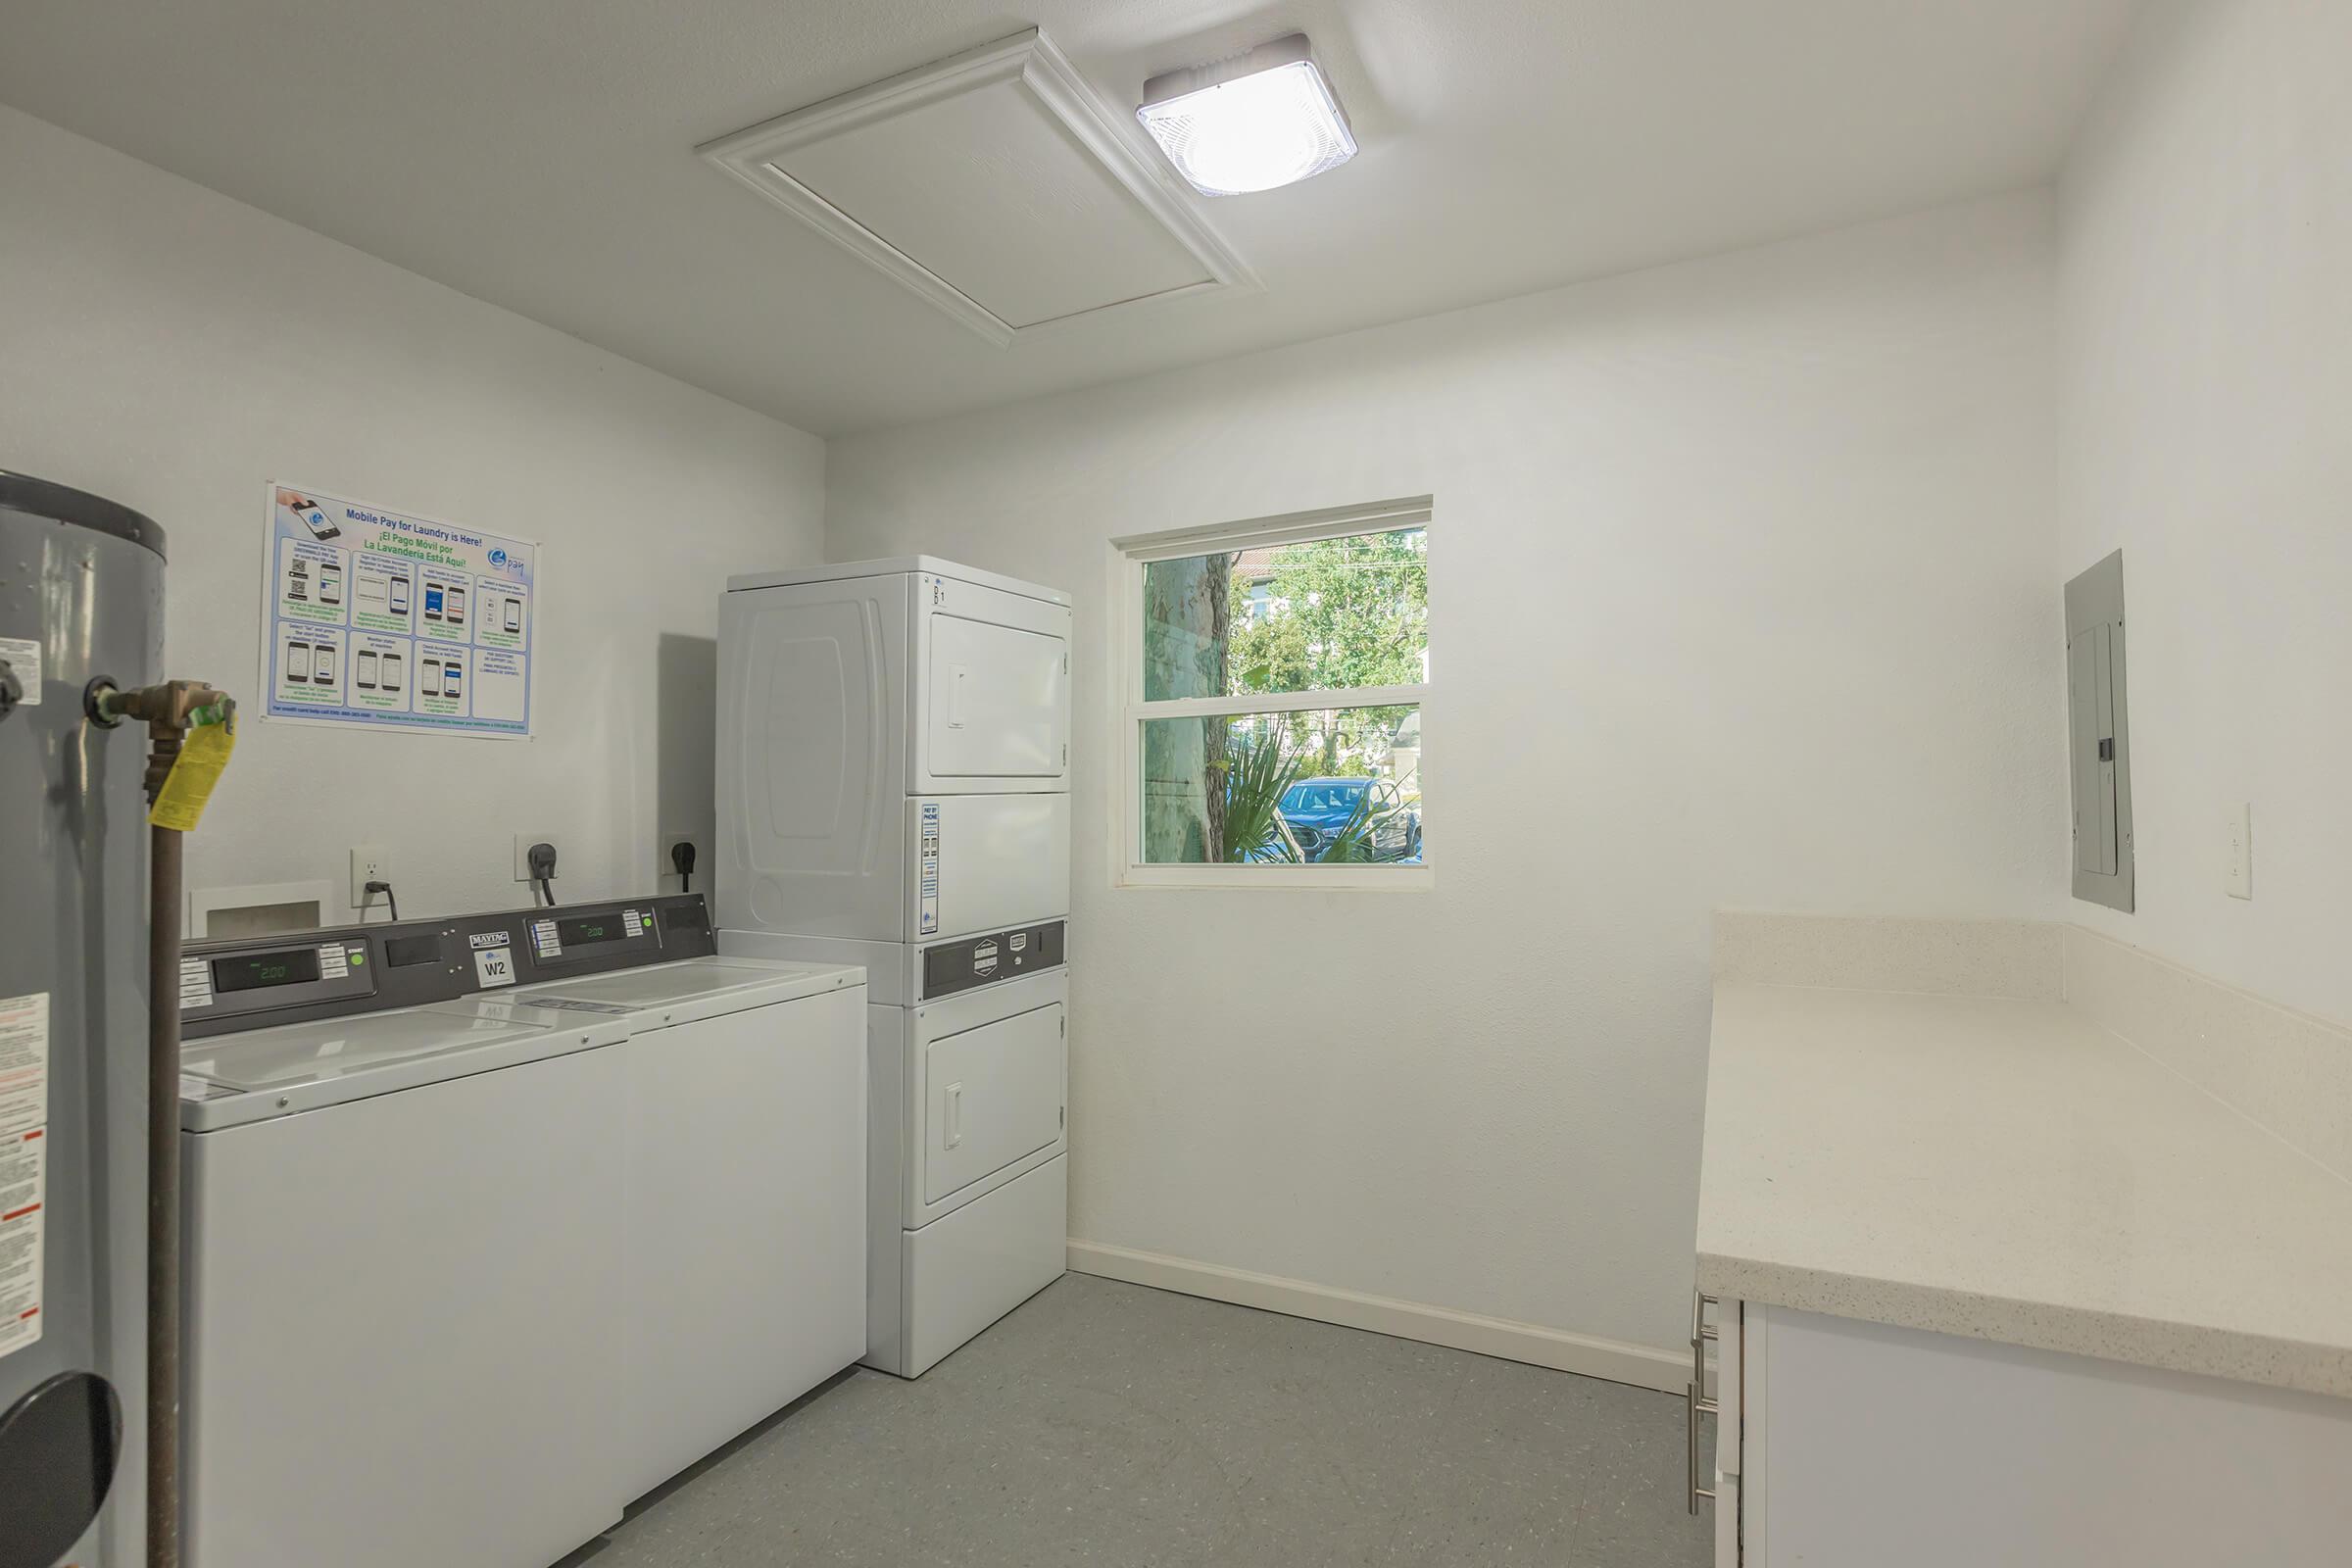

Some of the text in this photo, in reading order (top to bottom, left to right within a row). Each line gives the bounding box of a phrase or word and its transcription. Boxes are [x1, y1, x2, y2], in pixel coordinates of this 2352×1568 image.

[346, 508, 482, 547] Mobile Pay for Laundry is Here!
[378, 530, 453, 556] ¡El Pago Móvil por
[364, 539, 466, 570] La Lavandería Está Aquí!
[507, 558, 524, 576] pay
[472, 932, 508, 944] MAYTAG
[484, 961, 506, 976] W2
